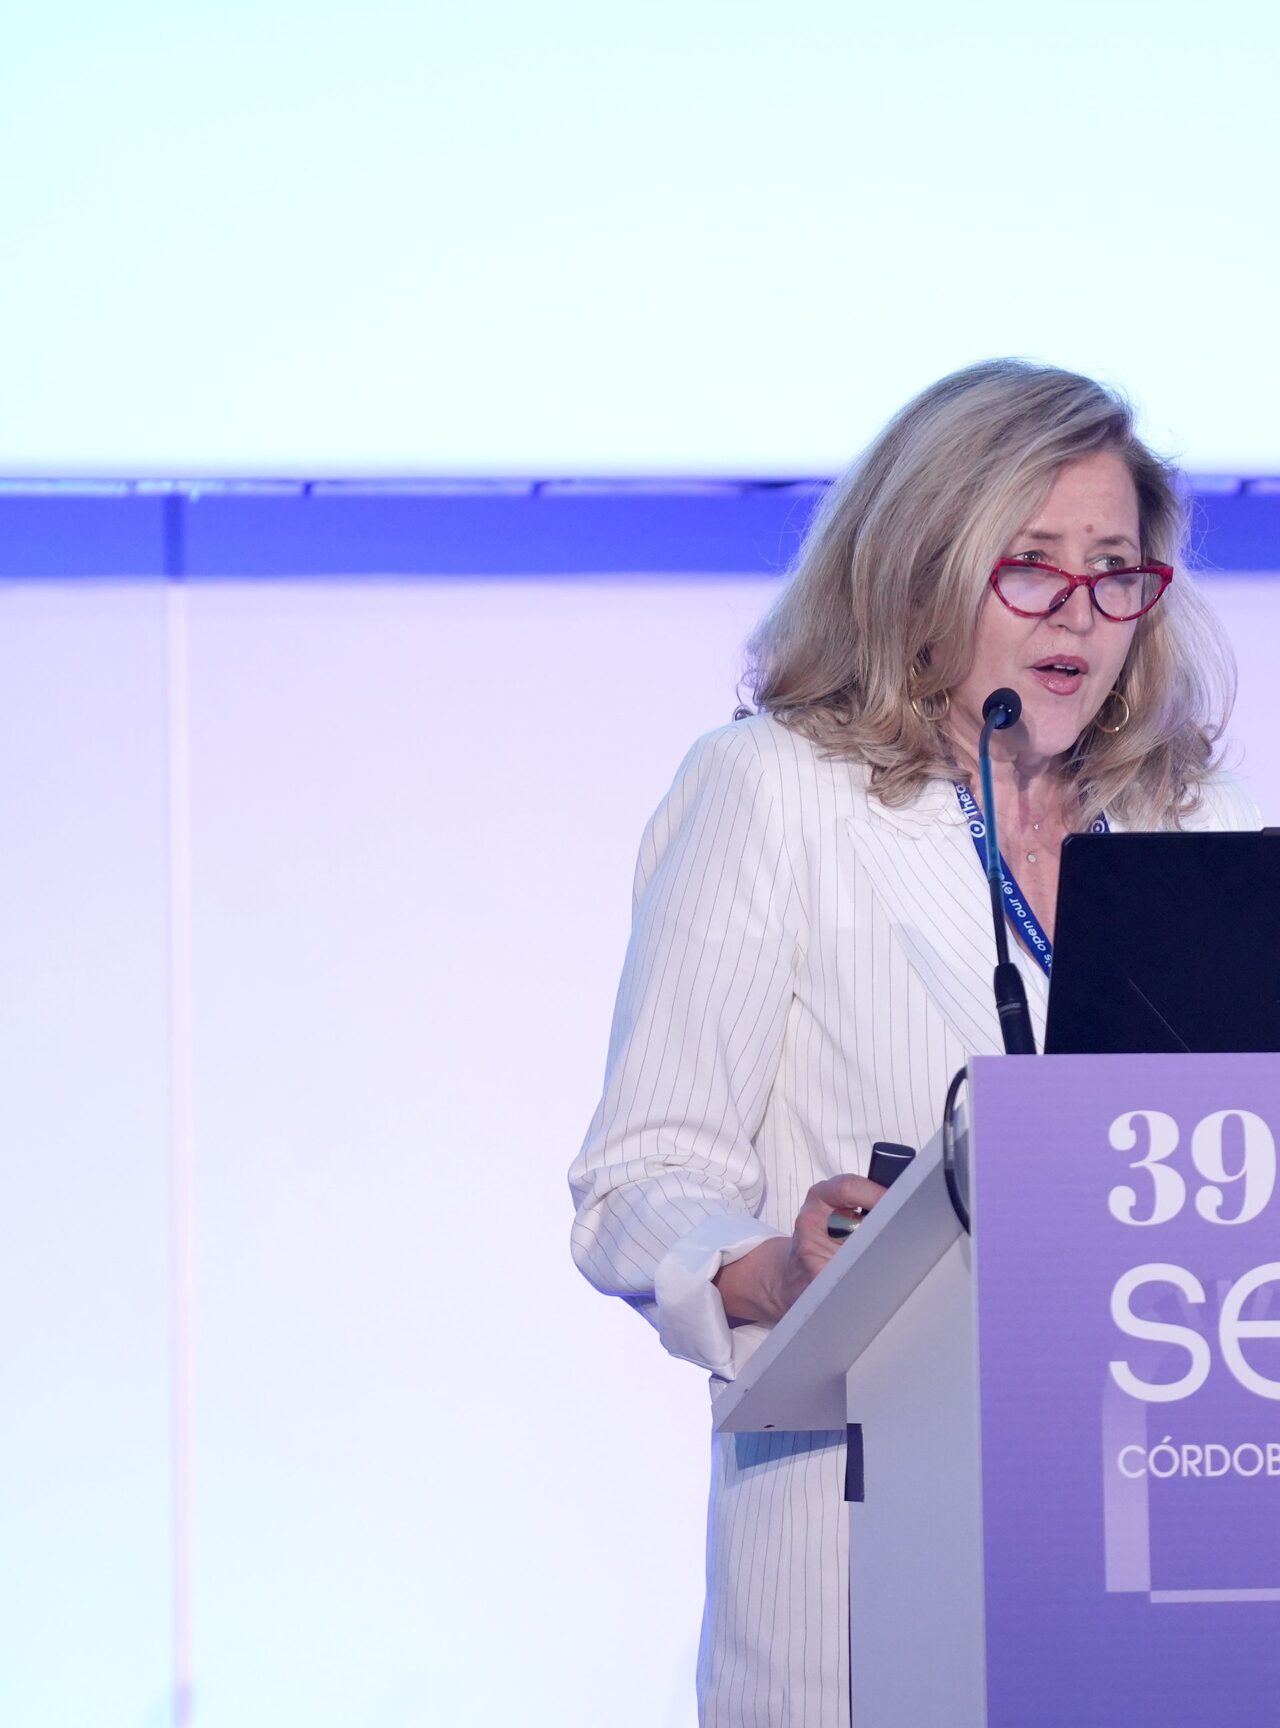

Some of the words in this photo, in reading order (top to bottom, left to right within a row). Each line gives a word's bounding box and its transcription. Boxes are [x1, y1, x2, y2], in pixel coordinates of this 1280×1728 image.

[1000, 873, 1014, 895] ey
[1009, 898, 1027, 918] our
[1023, 920, 1047, 952] open
